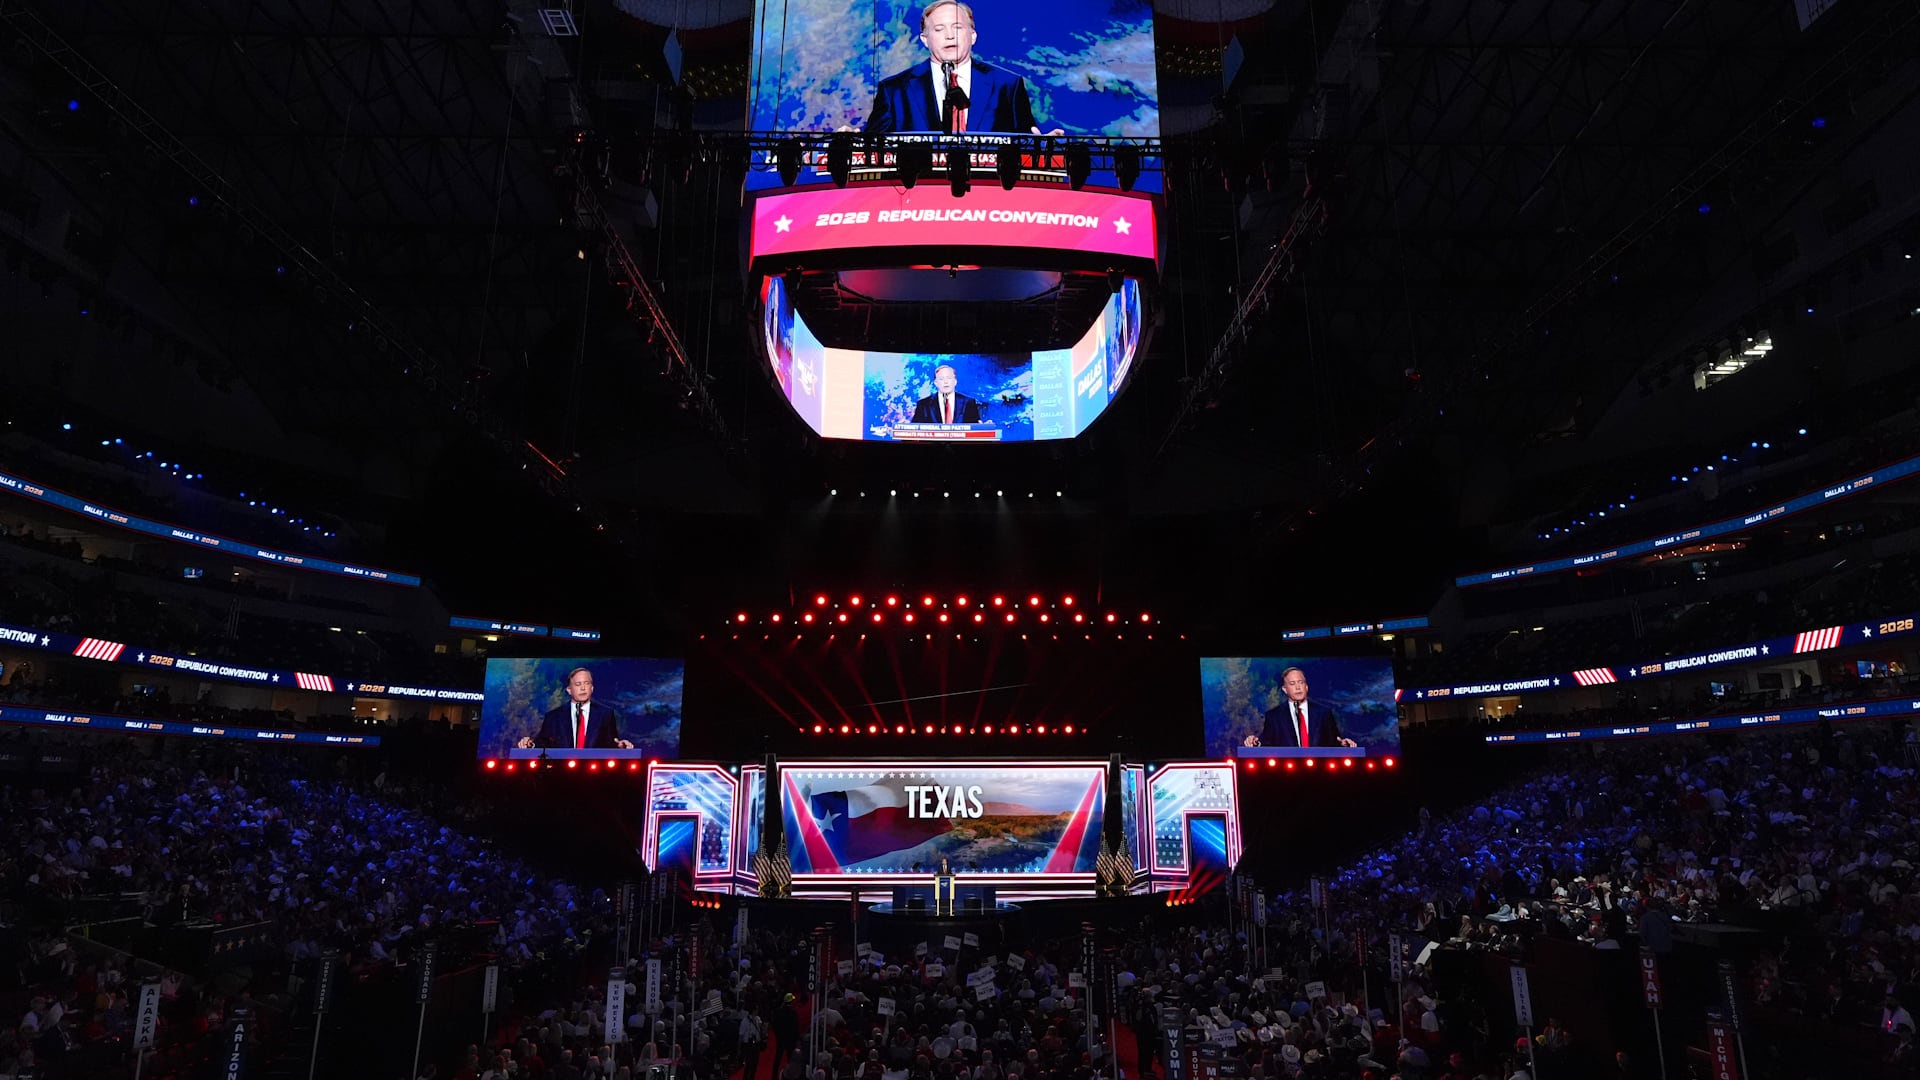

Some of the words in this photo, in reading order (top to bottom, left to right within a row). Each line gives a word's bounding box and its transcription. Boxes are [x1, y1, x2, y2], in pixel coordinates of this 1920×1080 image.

[816, 212, 870, 226] 2026
[878, 210, 986, 222] REPUBLICAN
[989, 210, 1098, 228] CONVENTION
[24, 485, 43, 495] 2026
[1825, 486, 1845, 497] DALLAS
[1854, 477, 1873, 488] 2026
[84, 505, 103, 515] DALLAS
[109, 514, 128, 523] 2026
[1745, 514, 1762, 524] DALLAS
[1769, 507, 1784, 516] 2026
[172, 530, 193, 539] DALLAS
[201, 537, 219, 545] 2026
[1655, 537, 1674, 546] DALLAS
[1682, 531, 1700, 539] 2026
[258, 551, 276, 559] DALLAS
[1574, 556, 1593, 564] DALLAS
[1601, 551, 1617, 559] 2026
[1880, 619, 1913, 634] 2026
[149, 655, 173, 665] 2026
[176, 659, 218, 673] REPUBLICAN
[219, 667, 268, 680] CONVENTION
[1641, 664, 1661, 674] 2026
[1665, 656, 1706, 670] REPUBLICAN
[1708, 647, 1757, 663] CONVENTION
[359, 684, 385, 692] 2026
[388, 687, 436, 697] REPUBLICAN
[438, 691, 484, 700] CONVENTION
[1454, 684, 1501, 694] REPUBLICAN
[1503, 679, 1549, 690] CONVENTION
[904, 785, 983, 819] TEXAS
[421, 952, 432, 1000] COLORADO
[1643, 958, 1658, 1003] UTAH
[1516, 970, 1527, 1022] LOUISIANA
[140, 988, 155, 1044] ALASKA
[227, 1023, 245, 1080] ARIZON
[1167, 1029, 1180, 1080] WYOMI
[1713, 1028, 1729, 1080] MICHIG
[1191, 1050, 1199, 1080] SOUTH
[1206, 1066, 1217, 1080] M
